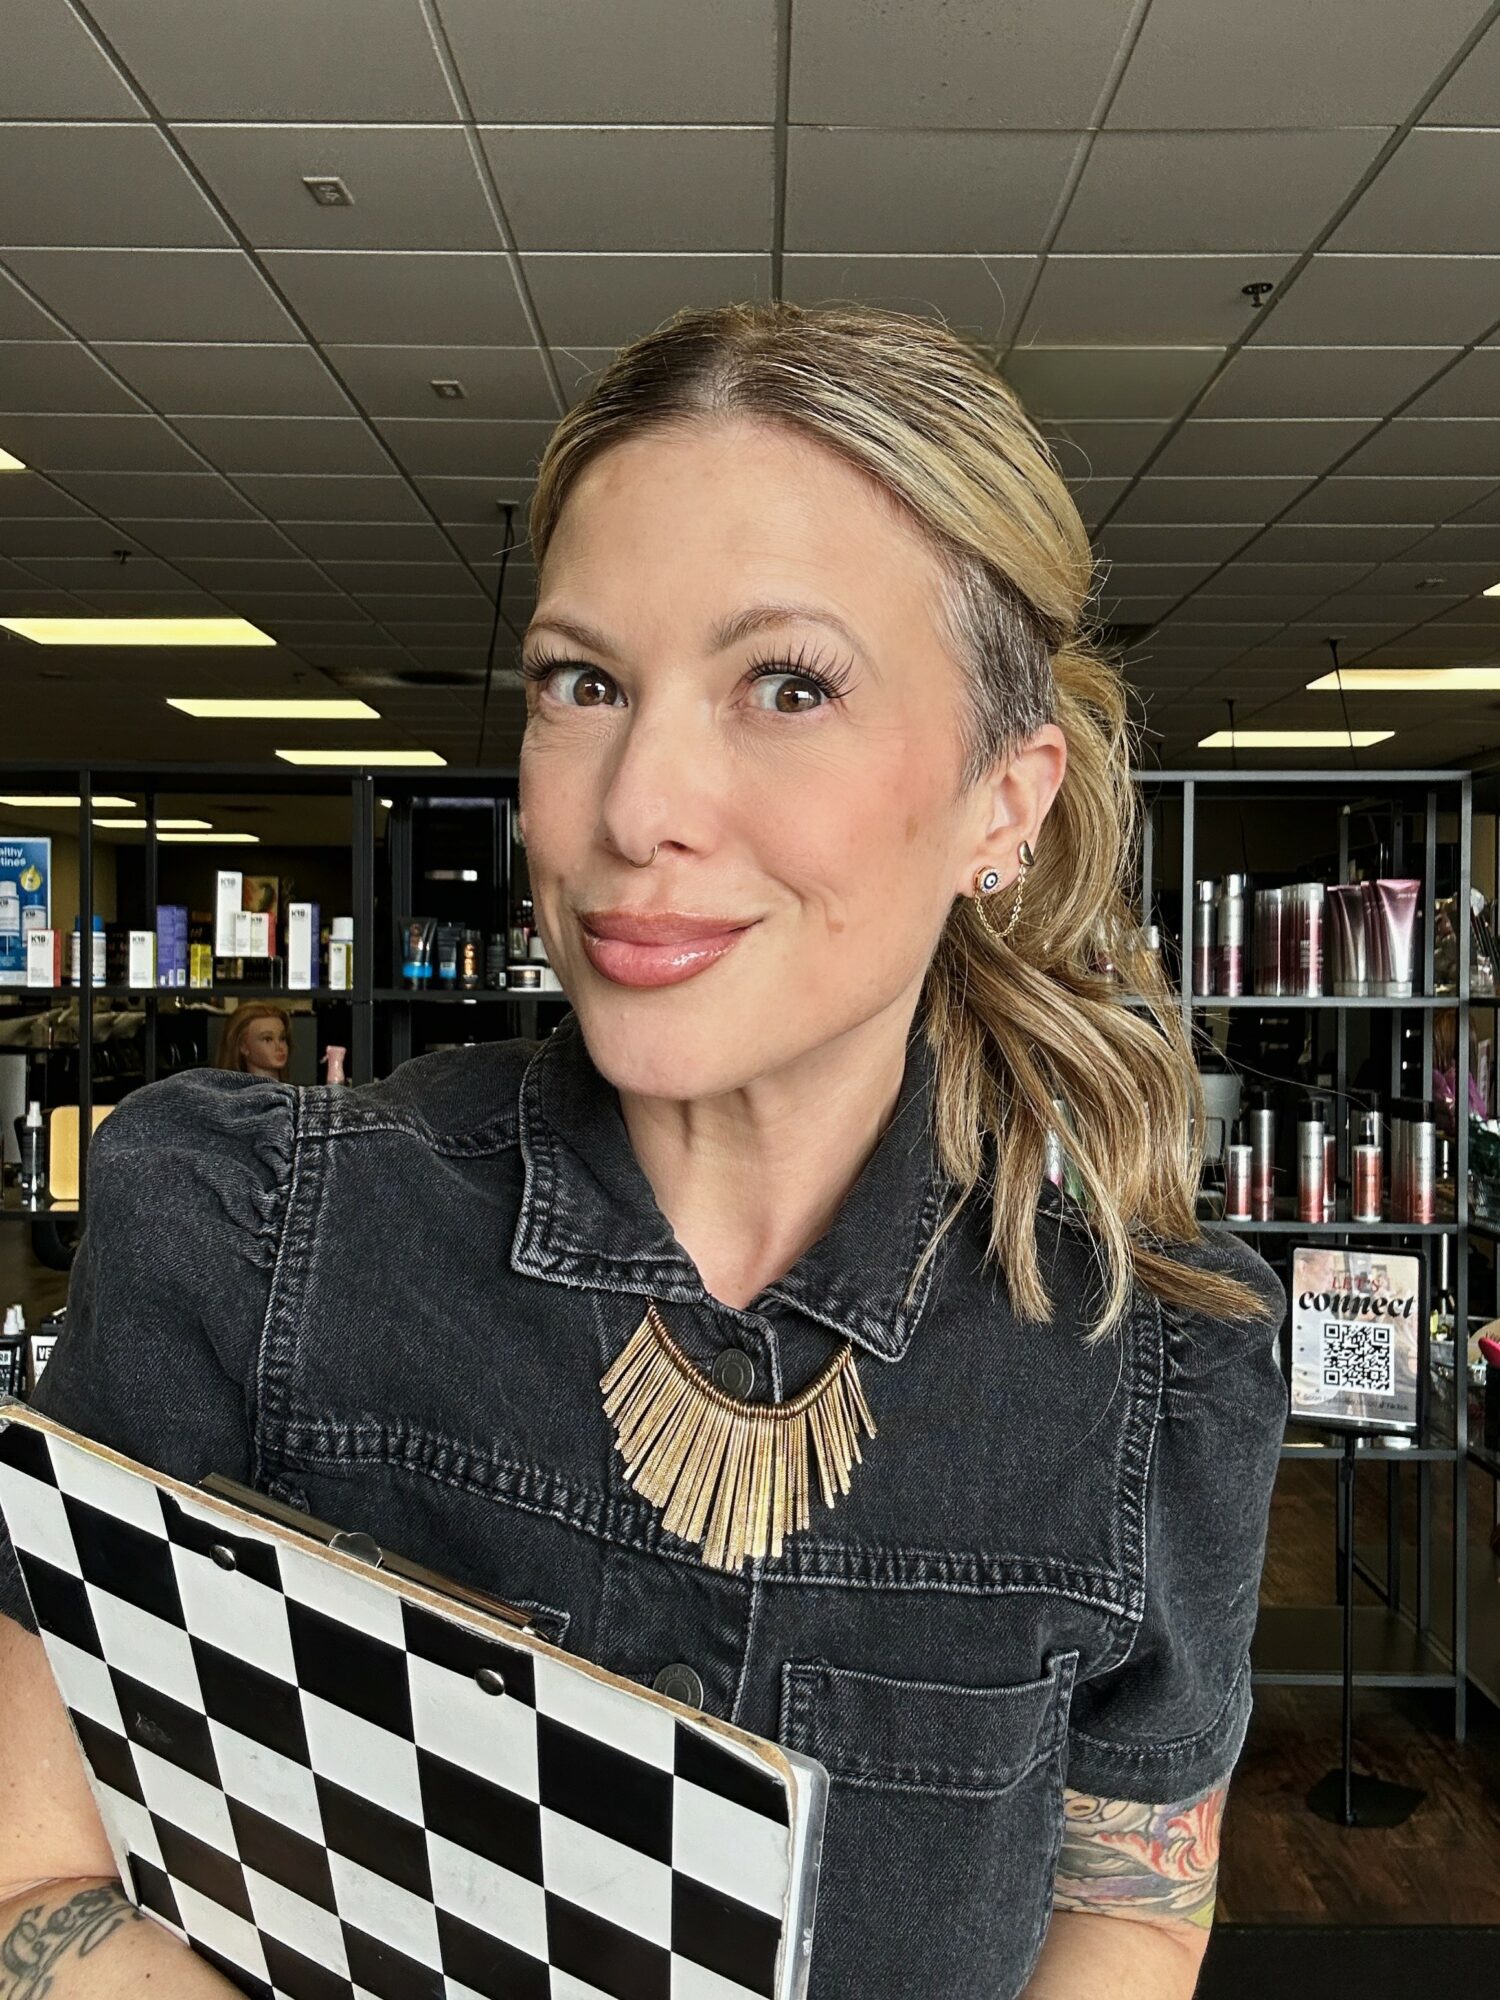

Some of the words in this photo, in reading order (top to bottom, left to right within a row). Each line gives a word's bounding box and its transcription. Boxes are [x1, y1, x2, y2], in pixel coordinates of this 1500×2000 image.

[220, 878, 236, 886] K18
[31, 935, 46, 943] K18
[1298, 1290, 1415, 1319] connect
